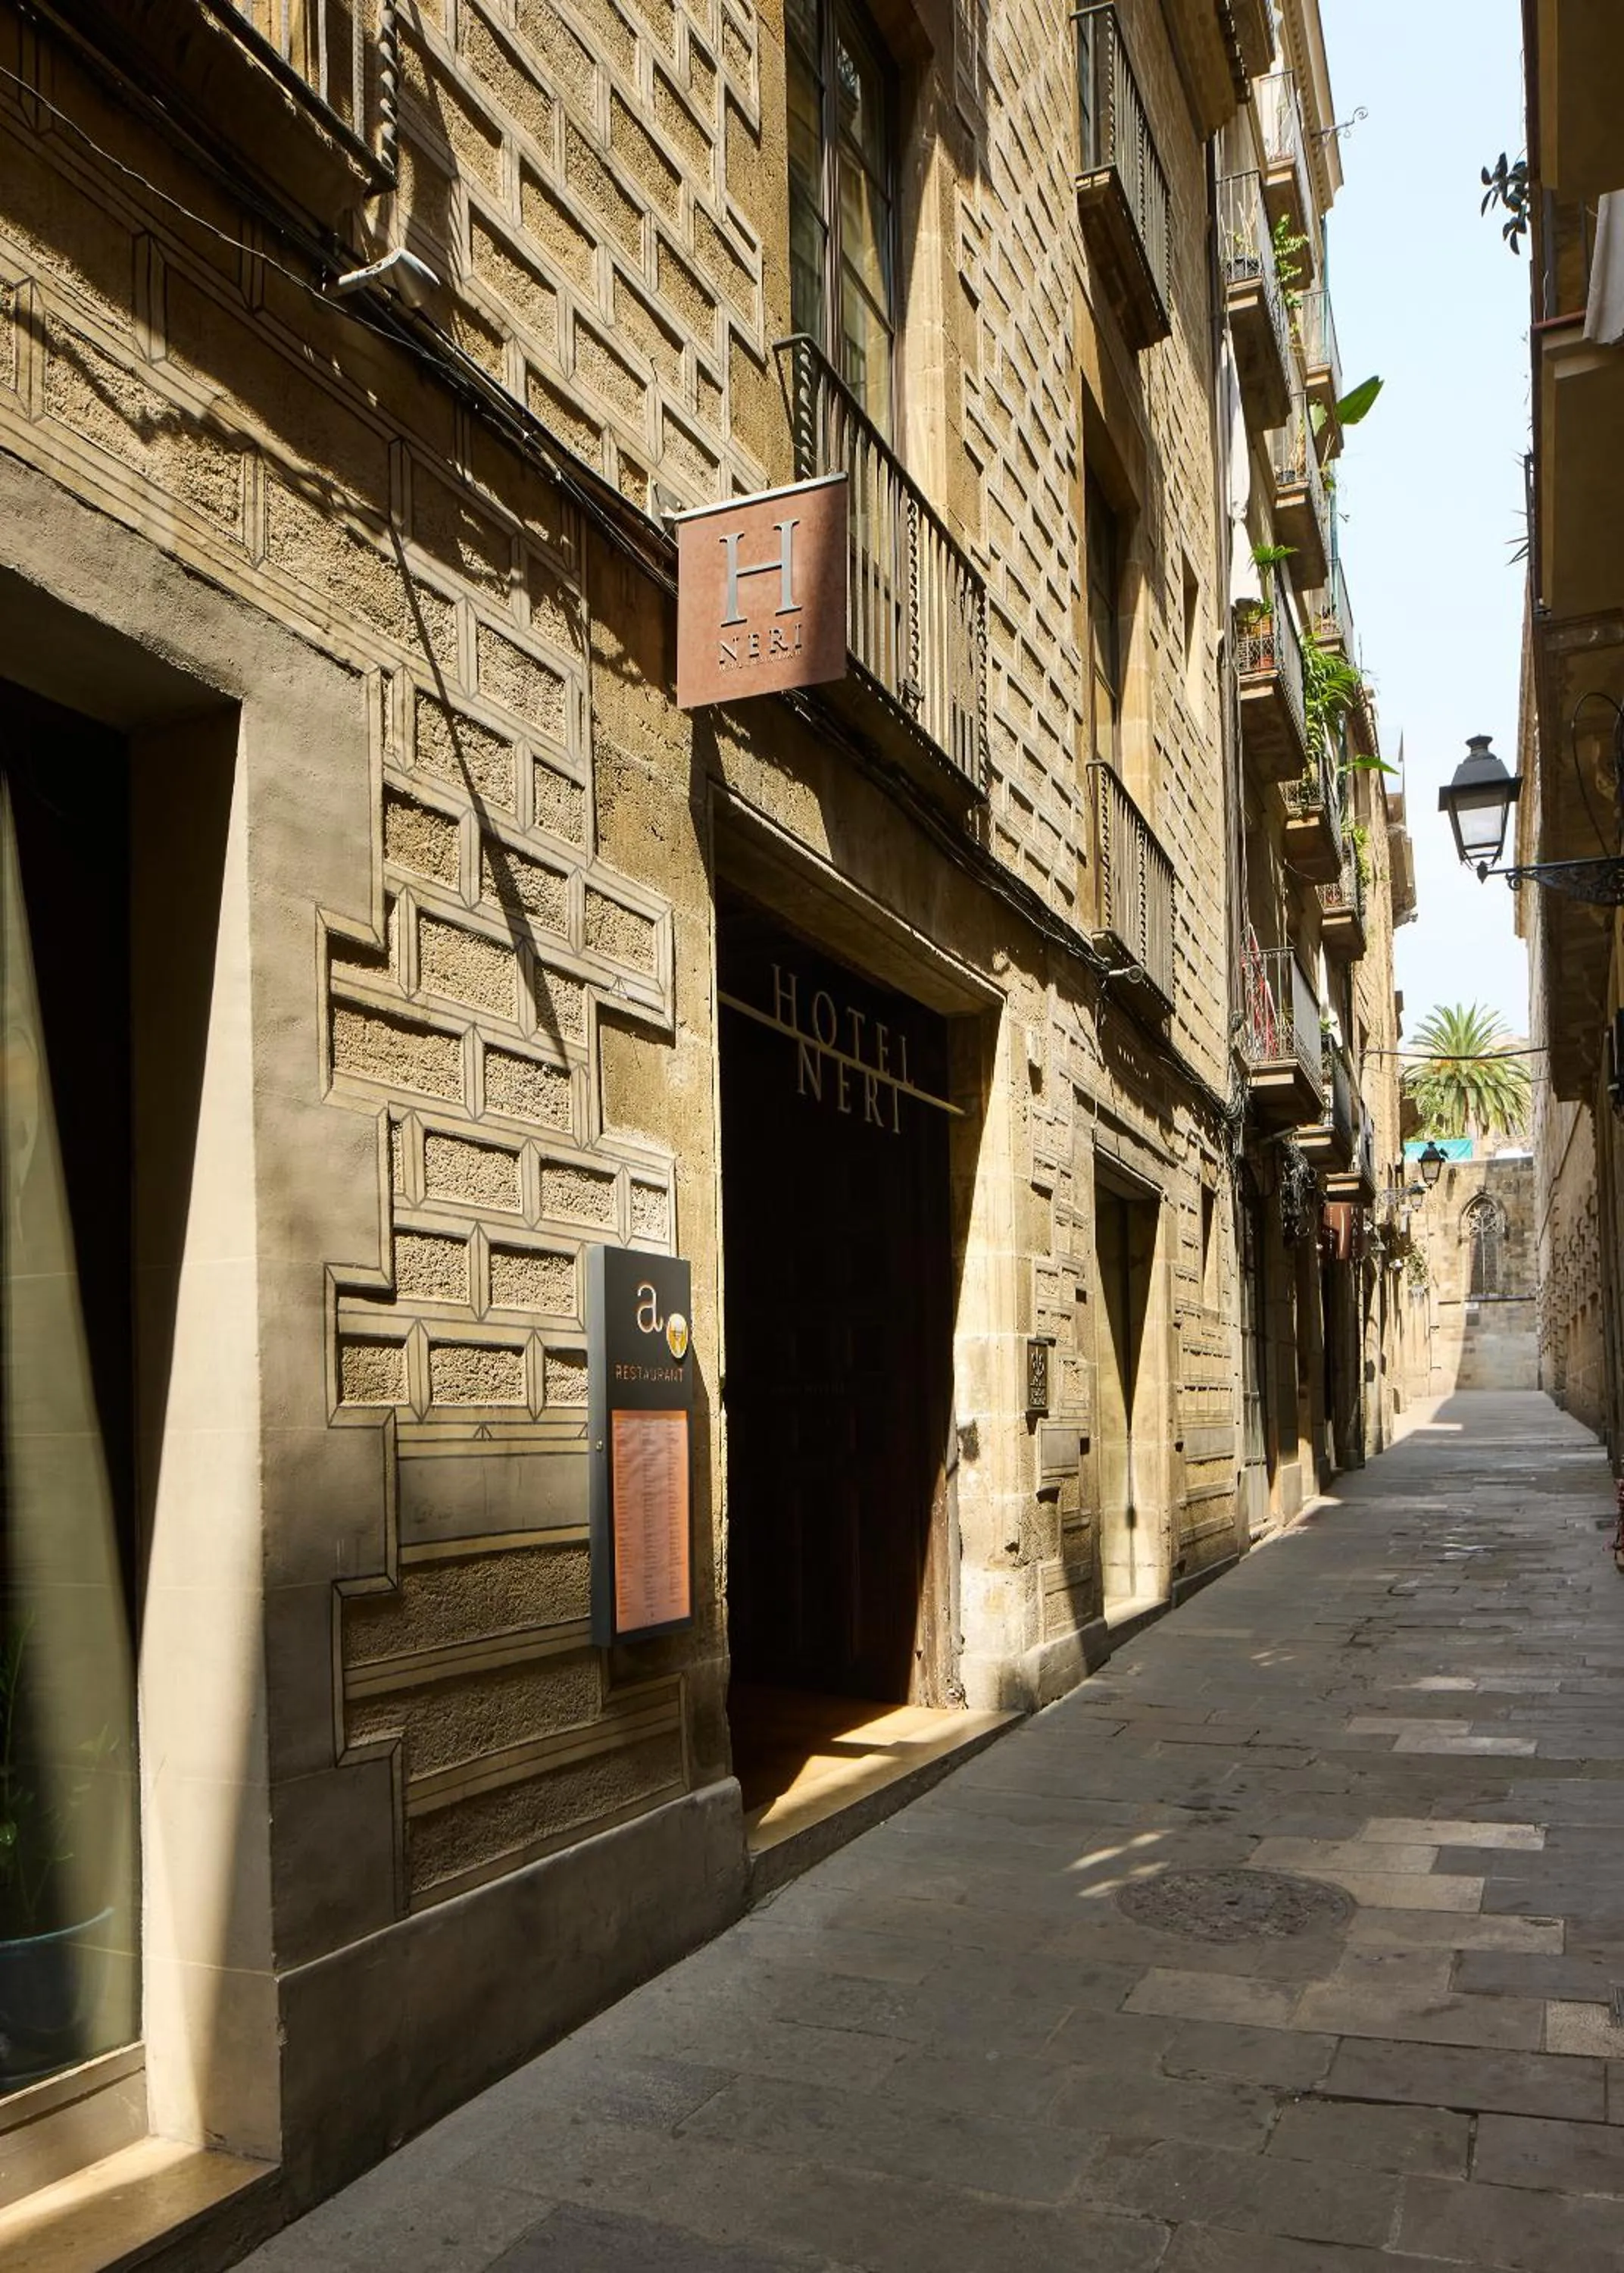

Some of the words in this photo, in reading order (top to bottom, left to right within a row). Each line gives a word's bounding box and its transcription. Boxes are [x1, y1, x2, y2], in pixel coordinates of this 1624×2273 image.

[719, 519, 802, 627] H
[719, 624, 803, 664] NERI
[770, 963, 915, 1090] HOTEL
[796, 1039, 901, 1135] NERI
[615, 1364, 685, 1383] RESTAURANT
